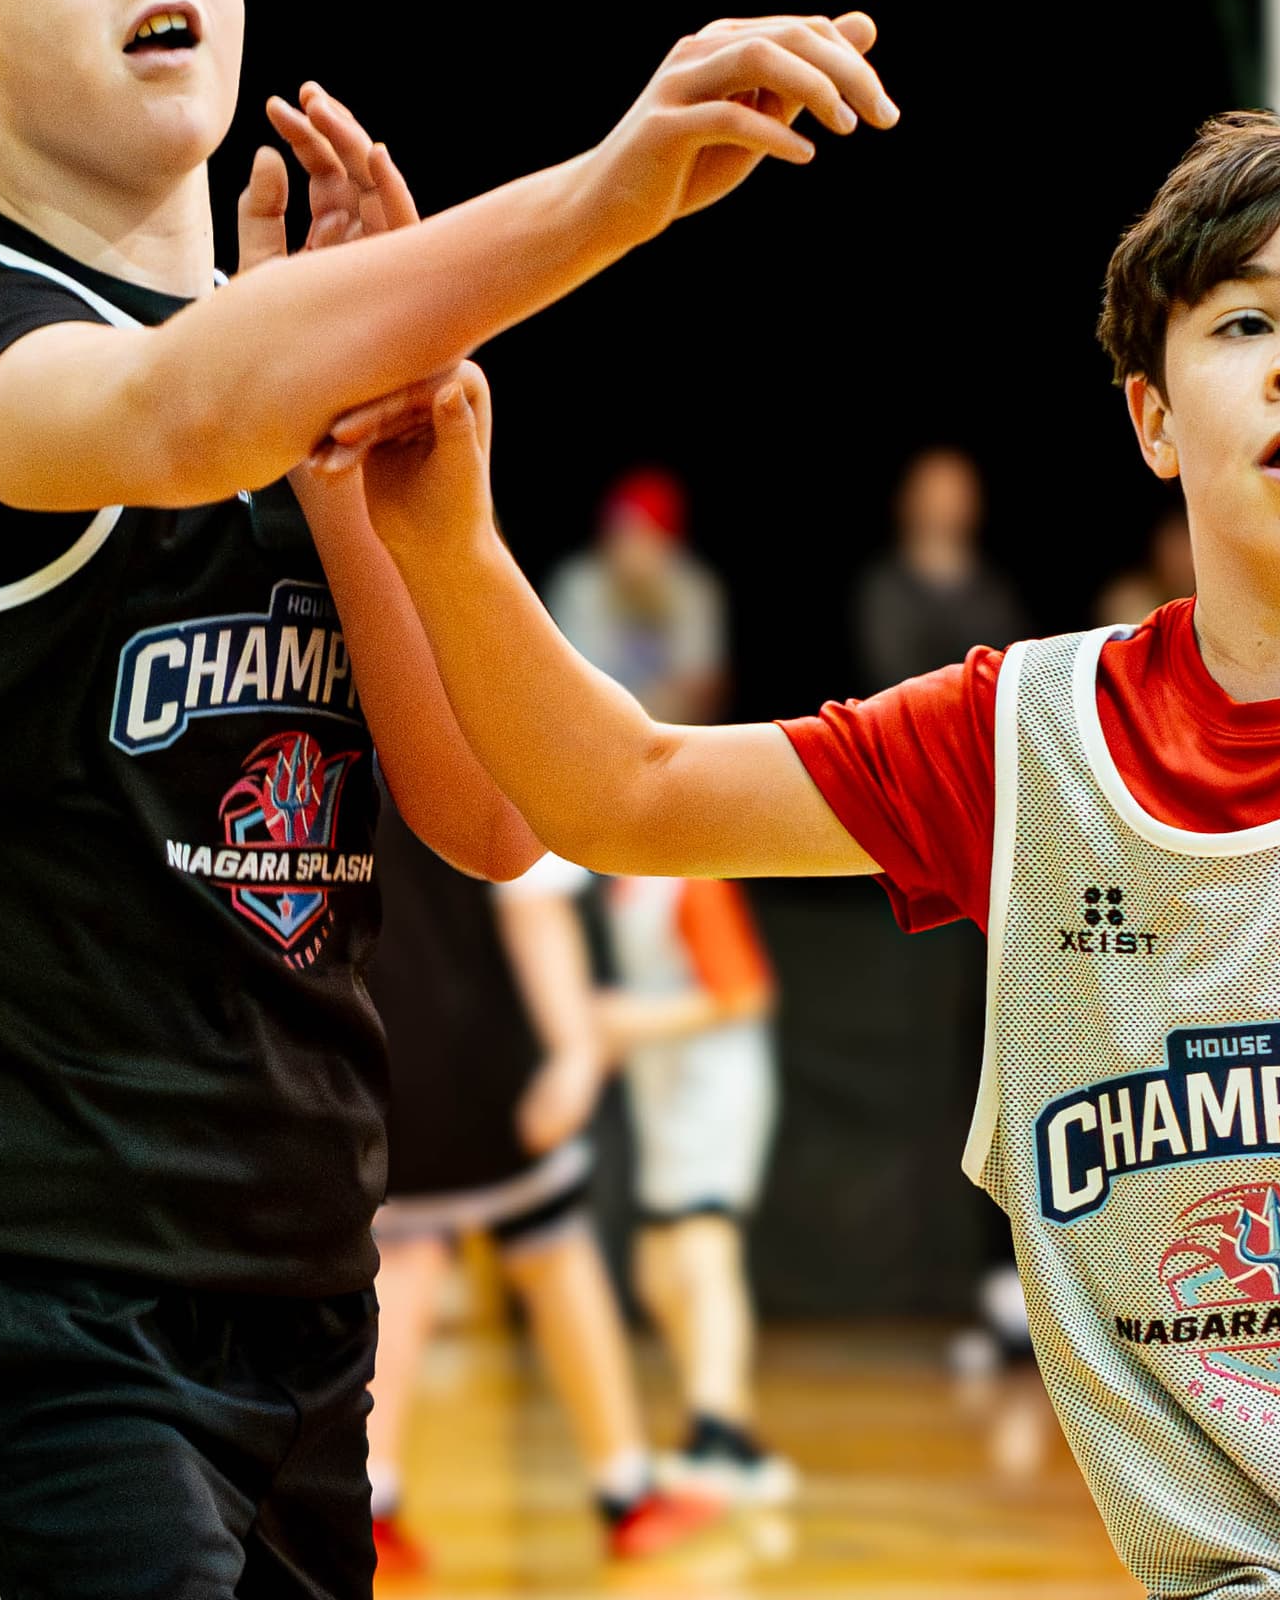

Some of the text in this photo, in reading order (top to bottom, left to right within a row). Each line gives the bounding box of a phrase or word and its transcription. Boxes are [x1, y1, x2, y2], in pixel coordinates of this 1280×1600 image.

[166, 839, 374, 882] NIAGARA SPLASH
[1058, 929, 1159, 955] XEIST
[1186, 1034, 1272, 1059] HOUSE
